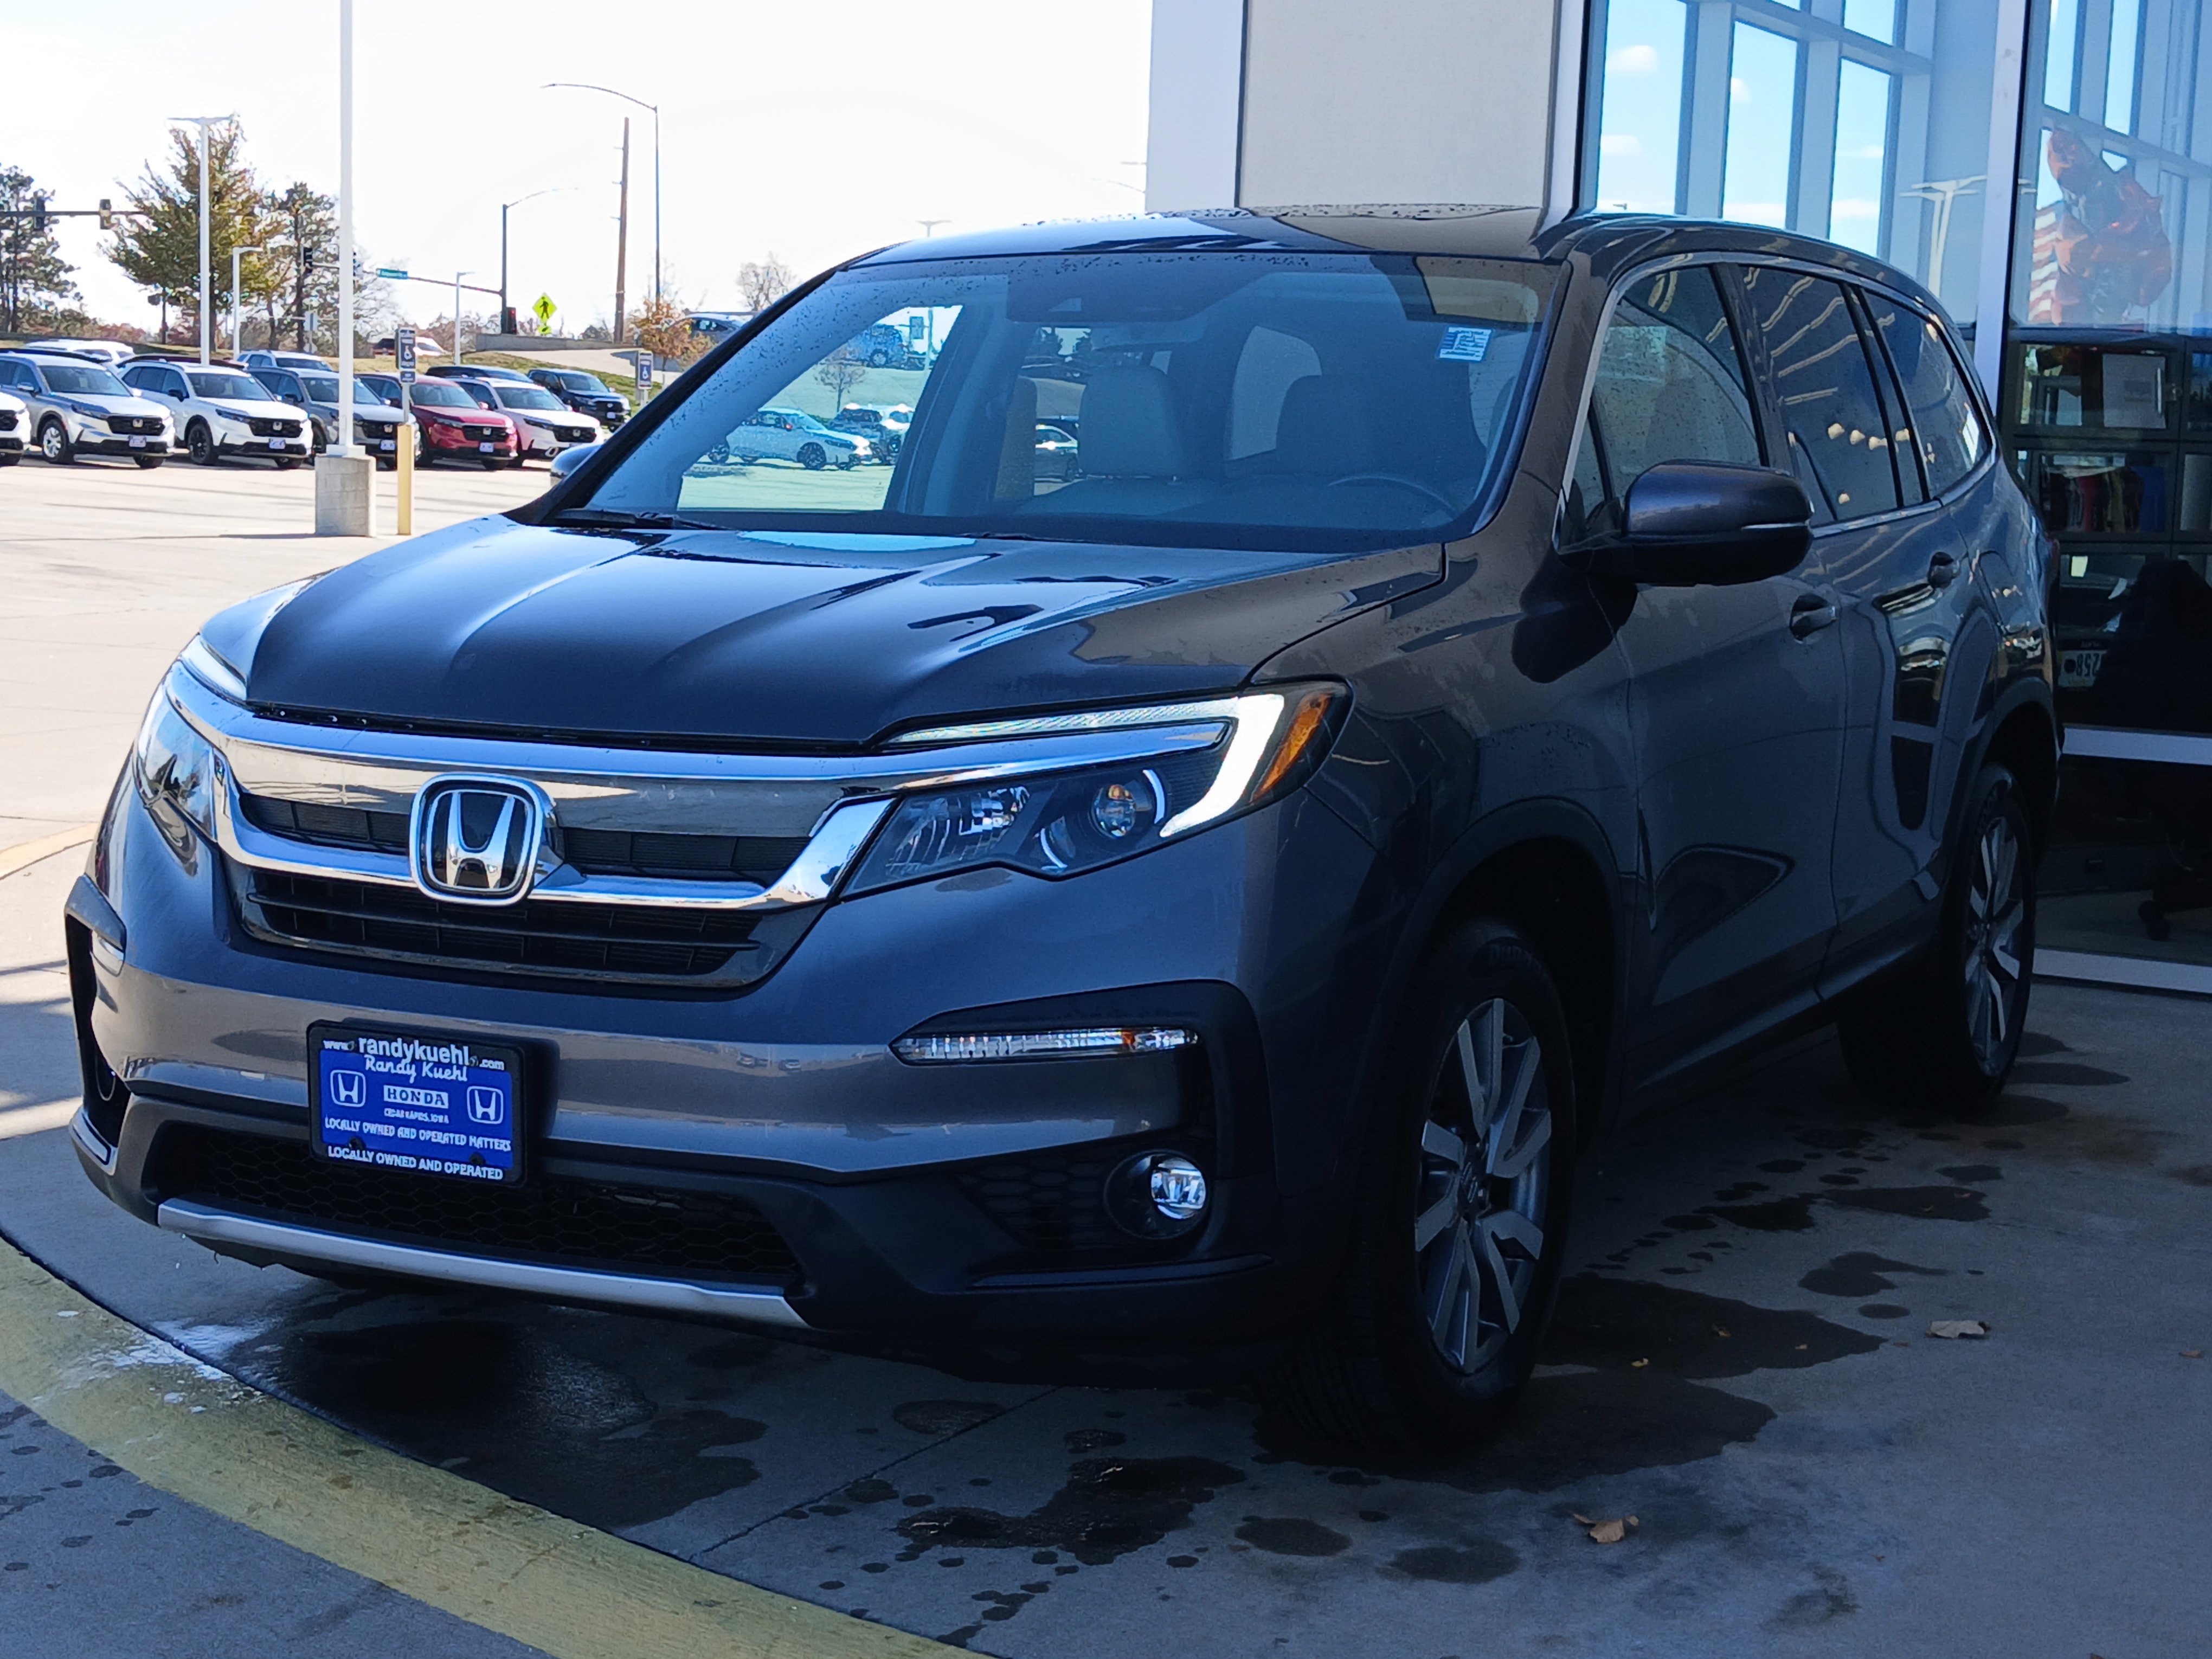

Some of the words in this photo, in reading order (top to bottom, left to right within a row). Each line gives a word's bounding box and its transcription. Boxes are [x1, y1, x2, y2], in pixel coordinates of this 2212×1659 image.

[358, 1038, 470, 1066] randykuehl
[364, 1055, 417, 1083] Randy
[422, 1062, 467, 1082] Kuehl
[387, 1088, 446, 1107] HONDA
[325, 1115, 361, 1133] LOCALLY
[363, 1123, 395, 1136] OWNED
[397, 1127, 417, 1140] AND
[419, 1130, 467, 1146] OPERATED
[468, 1136, 511, 1152] MATTERS
[328, 1146, 374, 1162] LOCALLY
[376, 1153, 417, 1168] OWNED
[418, 1159, 442, 1172] AND
[443, 1162, 504, 1180] OPERATED
